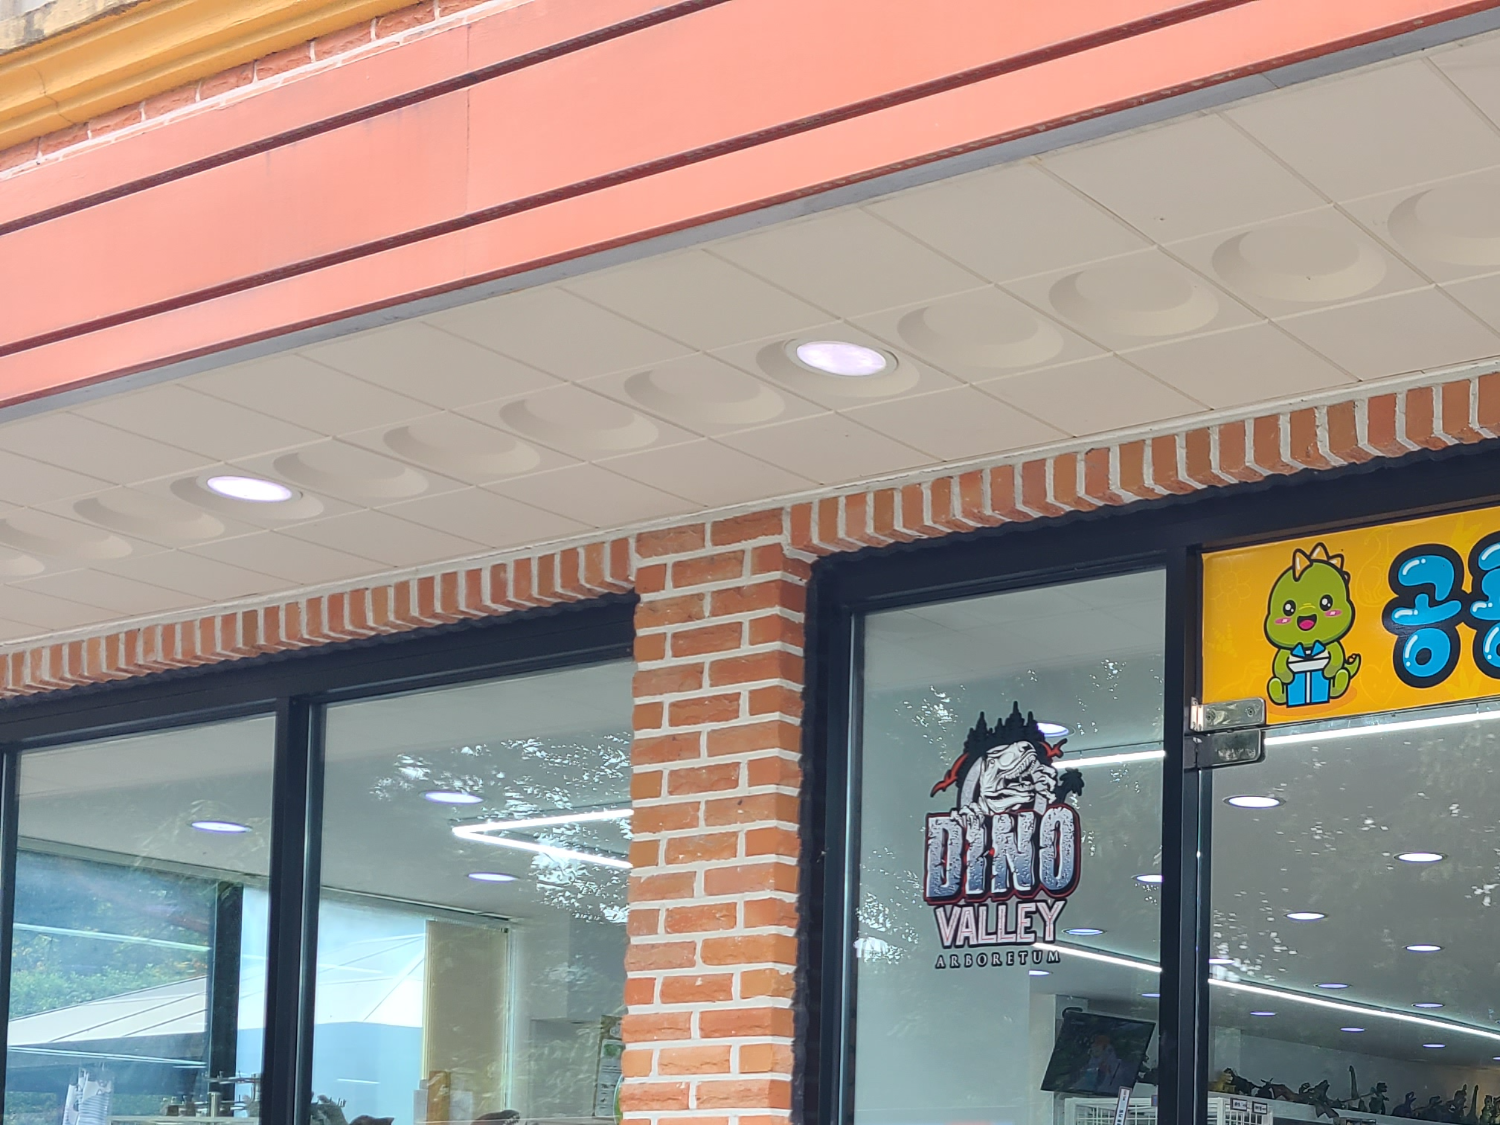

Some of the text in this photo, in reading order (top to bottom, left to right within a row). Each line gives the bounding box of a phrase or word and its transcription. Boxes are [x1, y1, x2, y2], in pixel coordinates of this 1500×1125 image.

[924, 804, 1081, 905] DINO
[935, 900, 1067, 948] VALLEY
[935, 950, 1061, 969] ARBORETUM
